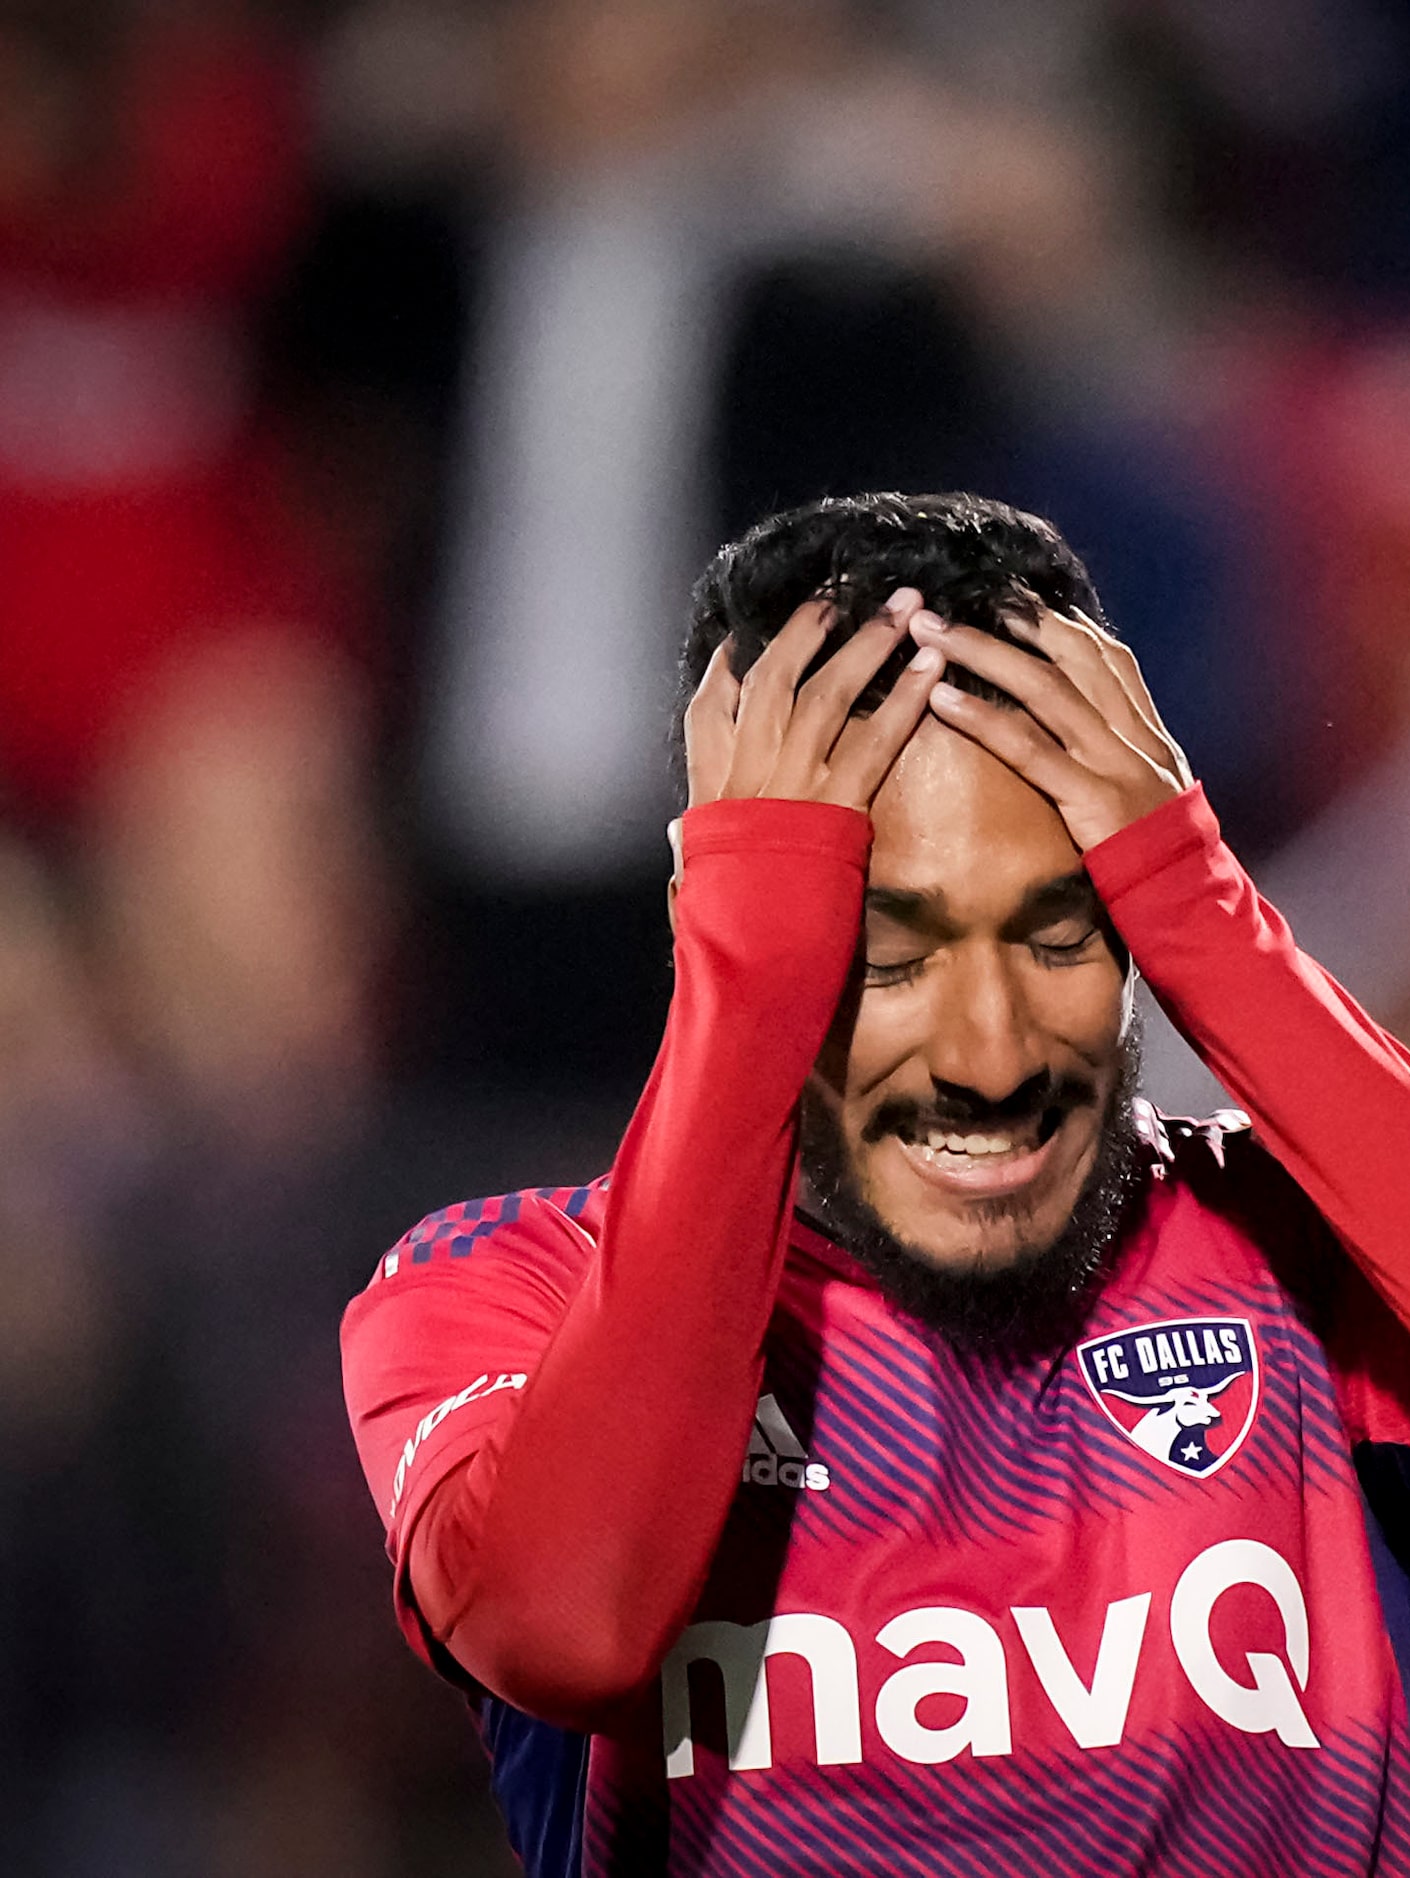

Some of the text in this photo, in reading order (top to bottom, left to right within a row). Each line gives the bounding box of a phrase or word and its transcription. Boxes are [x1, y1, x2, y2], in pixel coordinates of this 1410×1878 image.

[1092, 1328, 1243, 1384] FC DALLAS
[742, 1453, 831, 1491] idas
[661, 1538, 1321, 1779] mavQ
